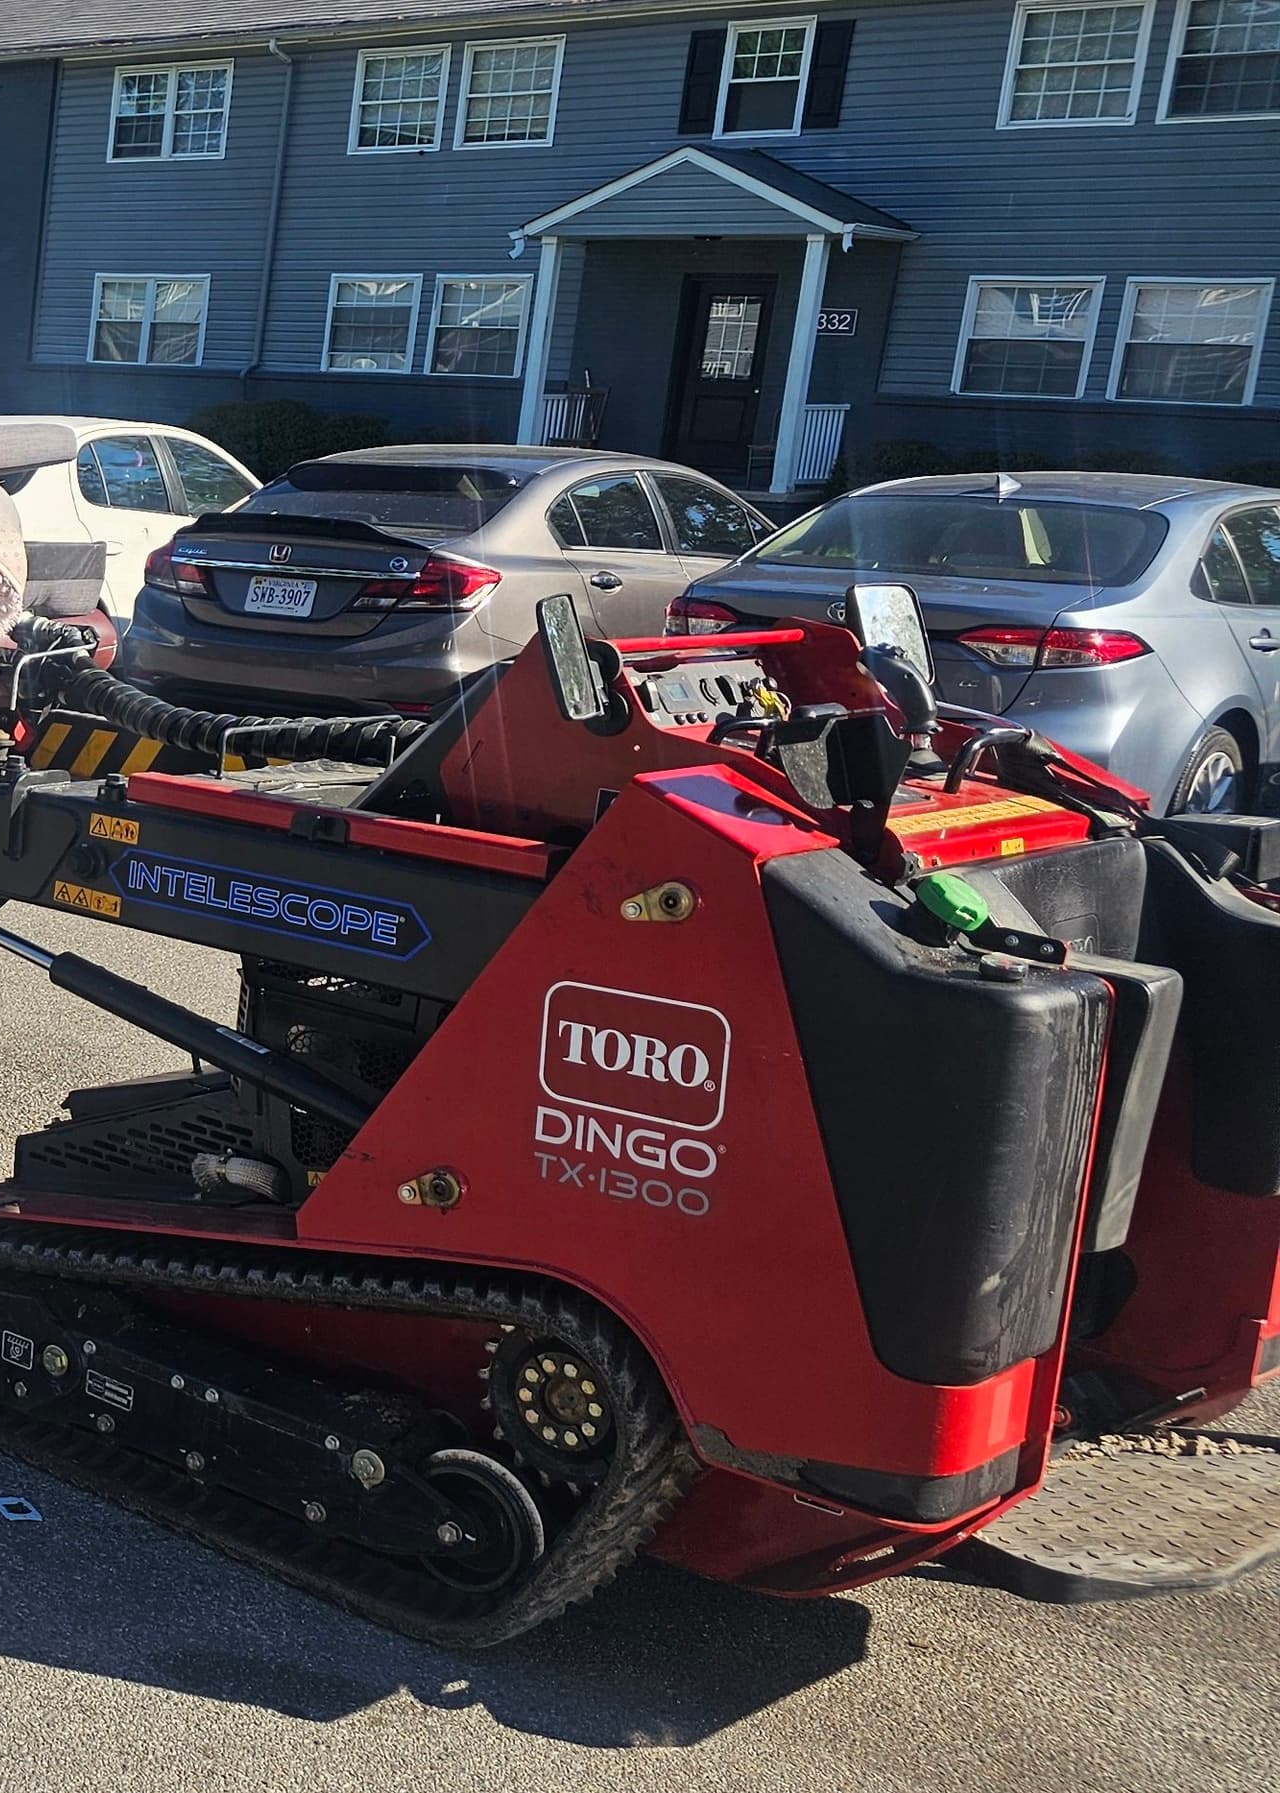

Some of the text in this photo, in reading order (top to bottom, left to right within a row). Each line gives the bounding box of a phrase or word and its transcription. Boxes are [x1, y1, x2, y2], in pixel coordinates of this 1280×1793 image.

[816, 313, 851, 330] 332
[251, 586, 311, 607] SWB-3907
[128, 860, 400, 945] INTELESCOPE
[558, 1020, 710, 1088] TORO
[535, 1106, 718, 1179] DINGO
